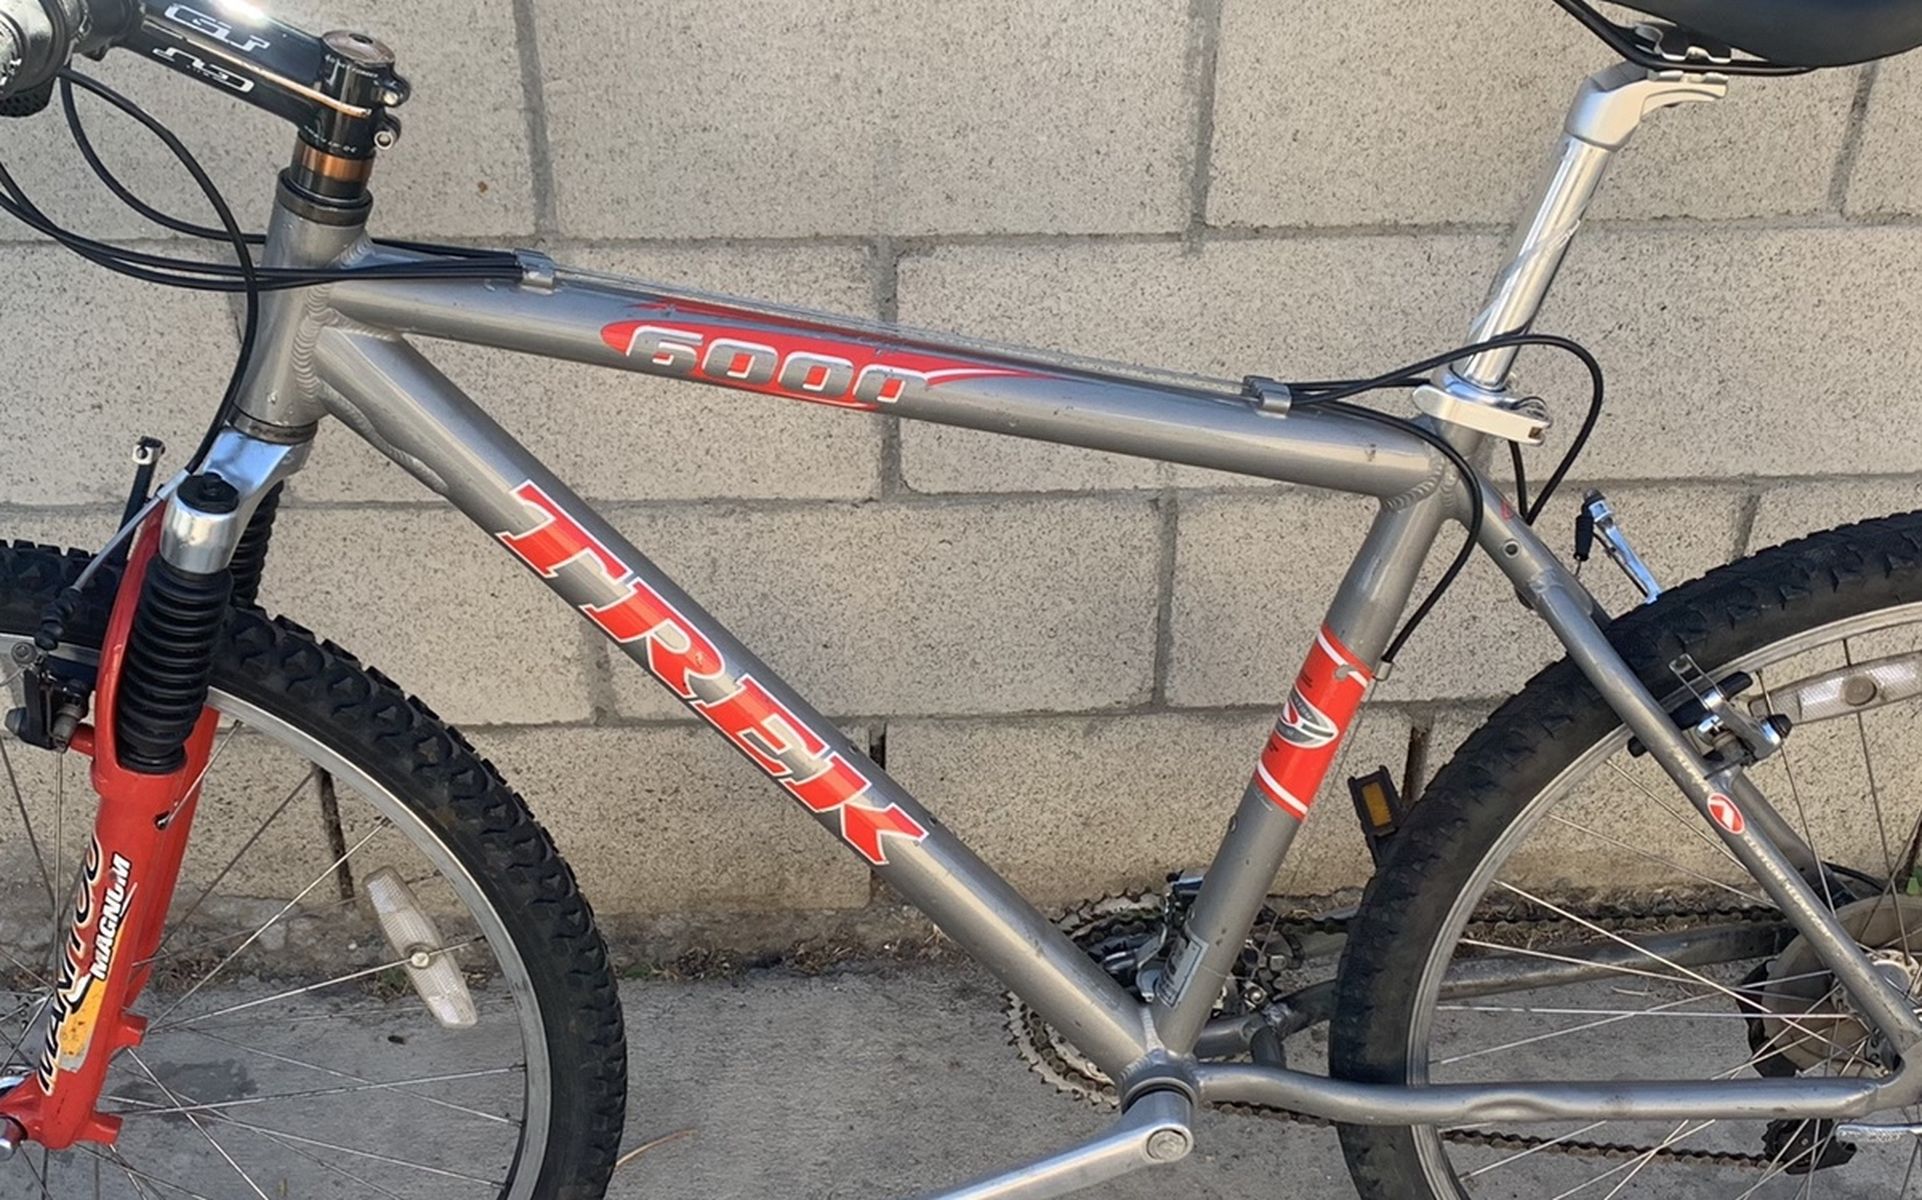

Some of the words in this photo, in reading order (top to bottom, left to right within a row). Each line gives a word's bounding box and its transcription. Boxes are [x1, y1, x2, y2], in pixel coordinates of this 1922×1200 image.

[625, 324, 930, 406] 6000
[495, 478, 929, 866] TREK
[89, 852, 132, 982] MAGNUM
